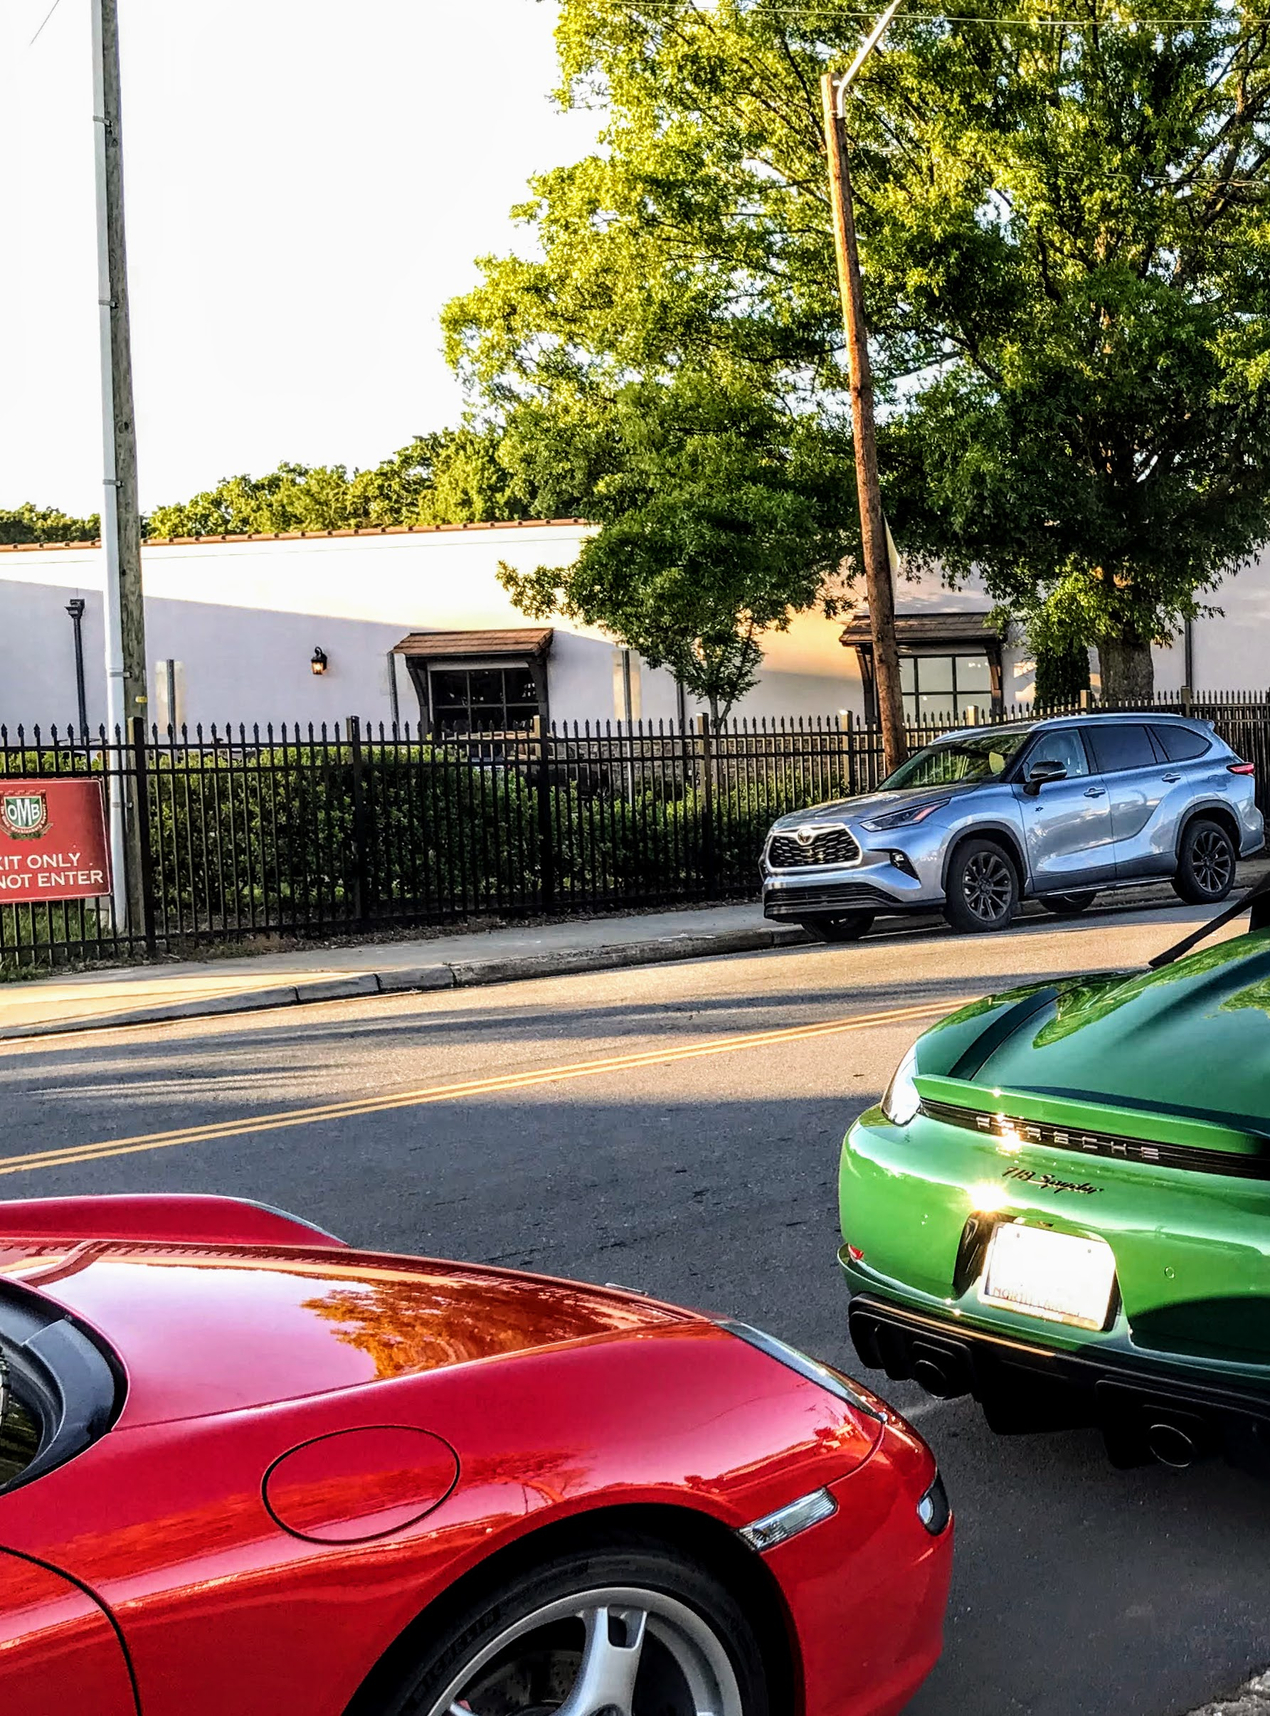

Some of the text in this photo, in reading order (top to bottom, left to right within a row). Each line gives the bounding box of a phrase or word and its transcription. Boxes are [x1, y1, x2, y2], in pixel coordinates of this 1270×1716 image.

[7, 798, 41, 826] OMB
[27, 853, 80, 869] ONLY
[38, 870, 103, 887] ENTER
[1002, 1166, 1104, 1194] 718 Spyder
